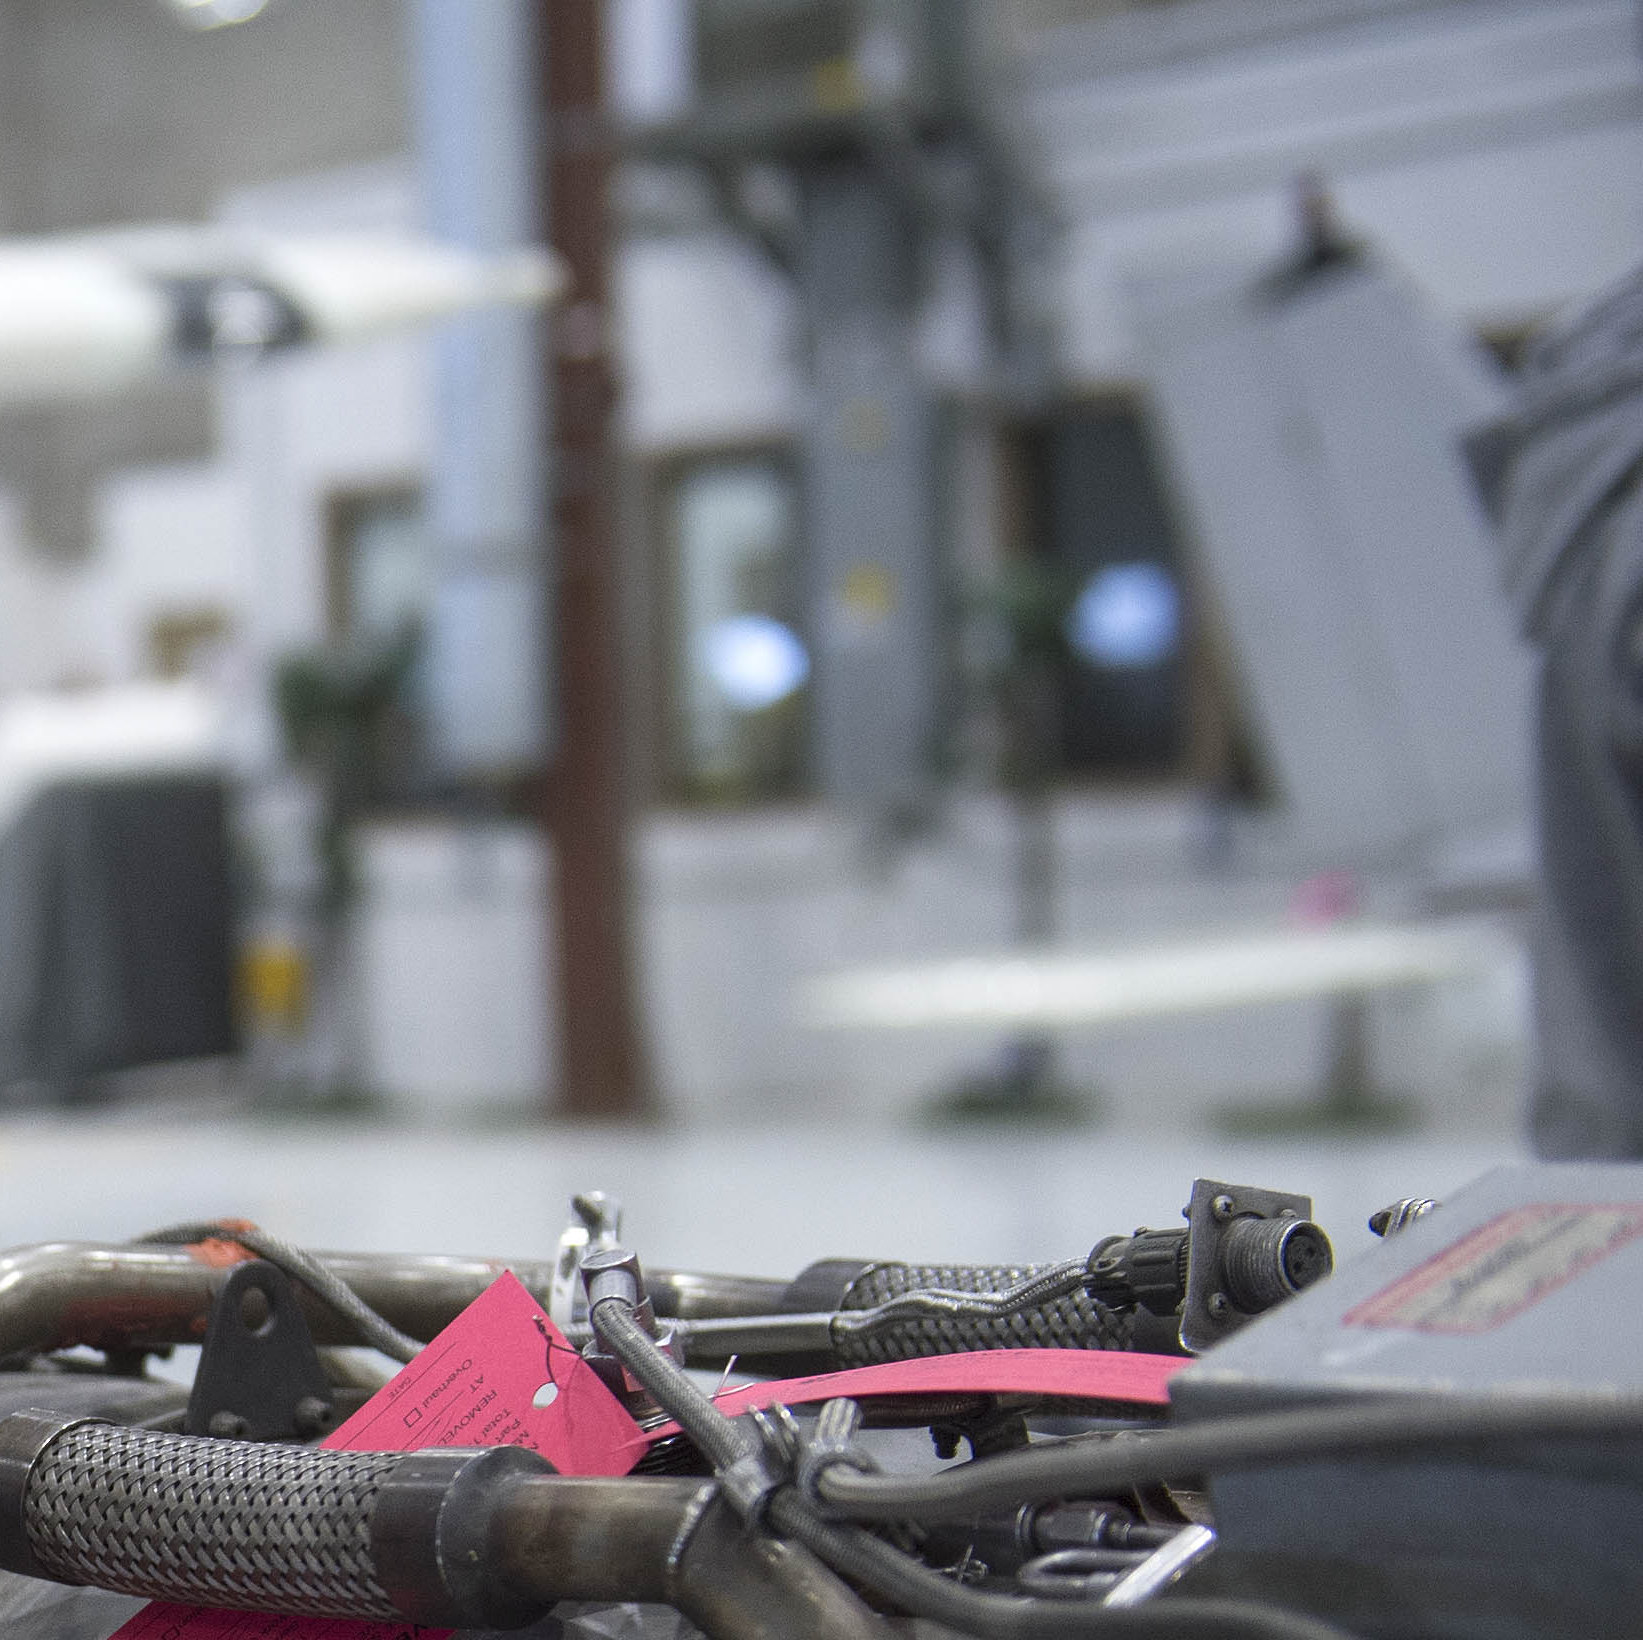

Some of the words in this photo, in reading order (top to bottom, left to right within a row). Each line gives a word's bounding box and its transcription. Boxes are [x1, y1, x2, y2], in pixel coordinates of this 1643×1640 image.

[386, 1375, 413, 1400] DATE
[420, 1357, 474, 1408] Overhaul
[466, 1373, 487, 1394] AT
[480, 1406, 511, 1436] Total
[494, 1417, 521, 1443] Part
